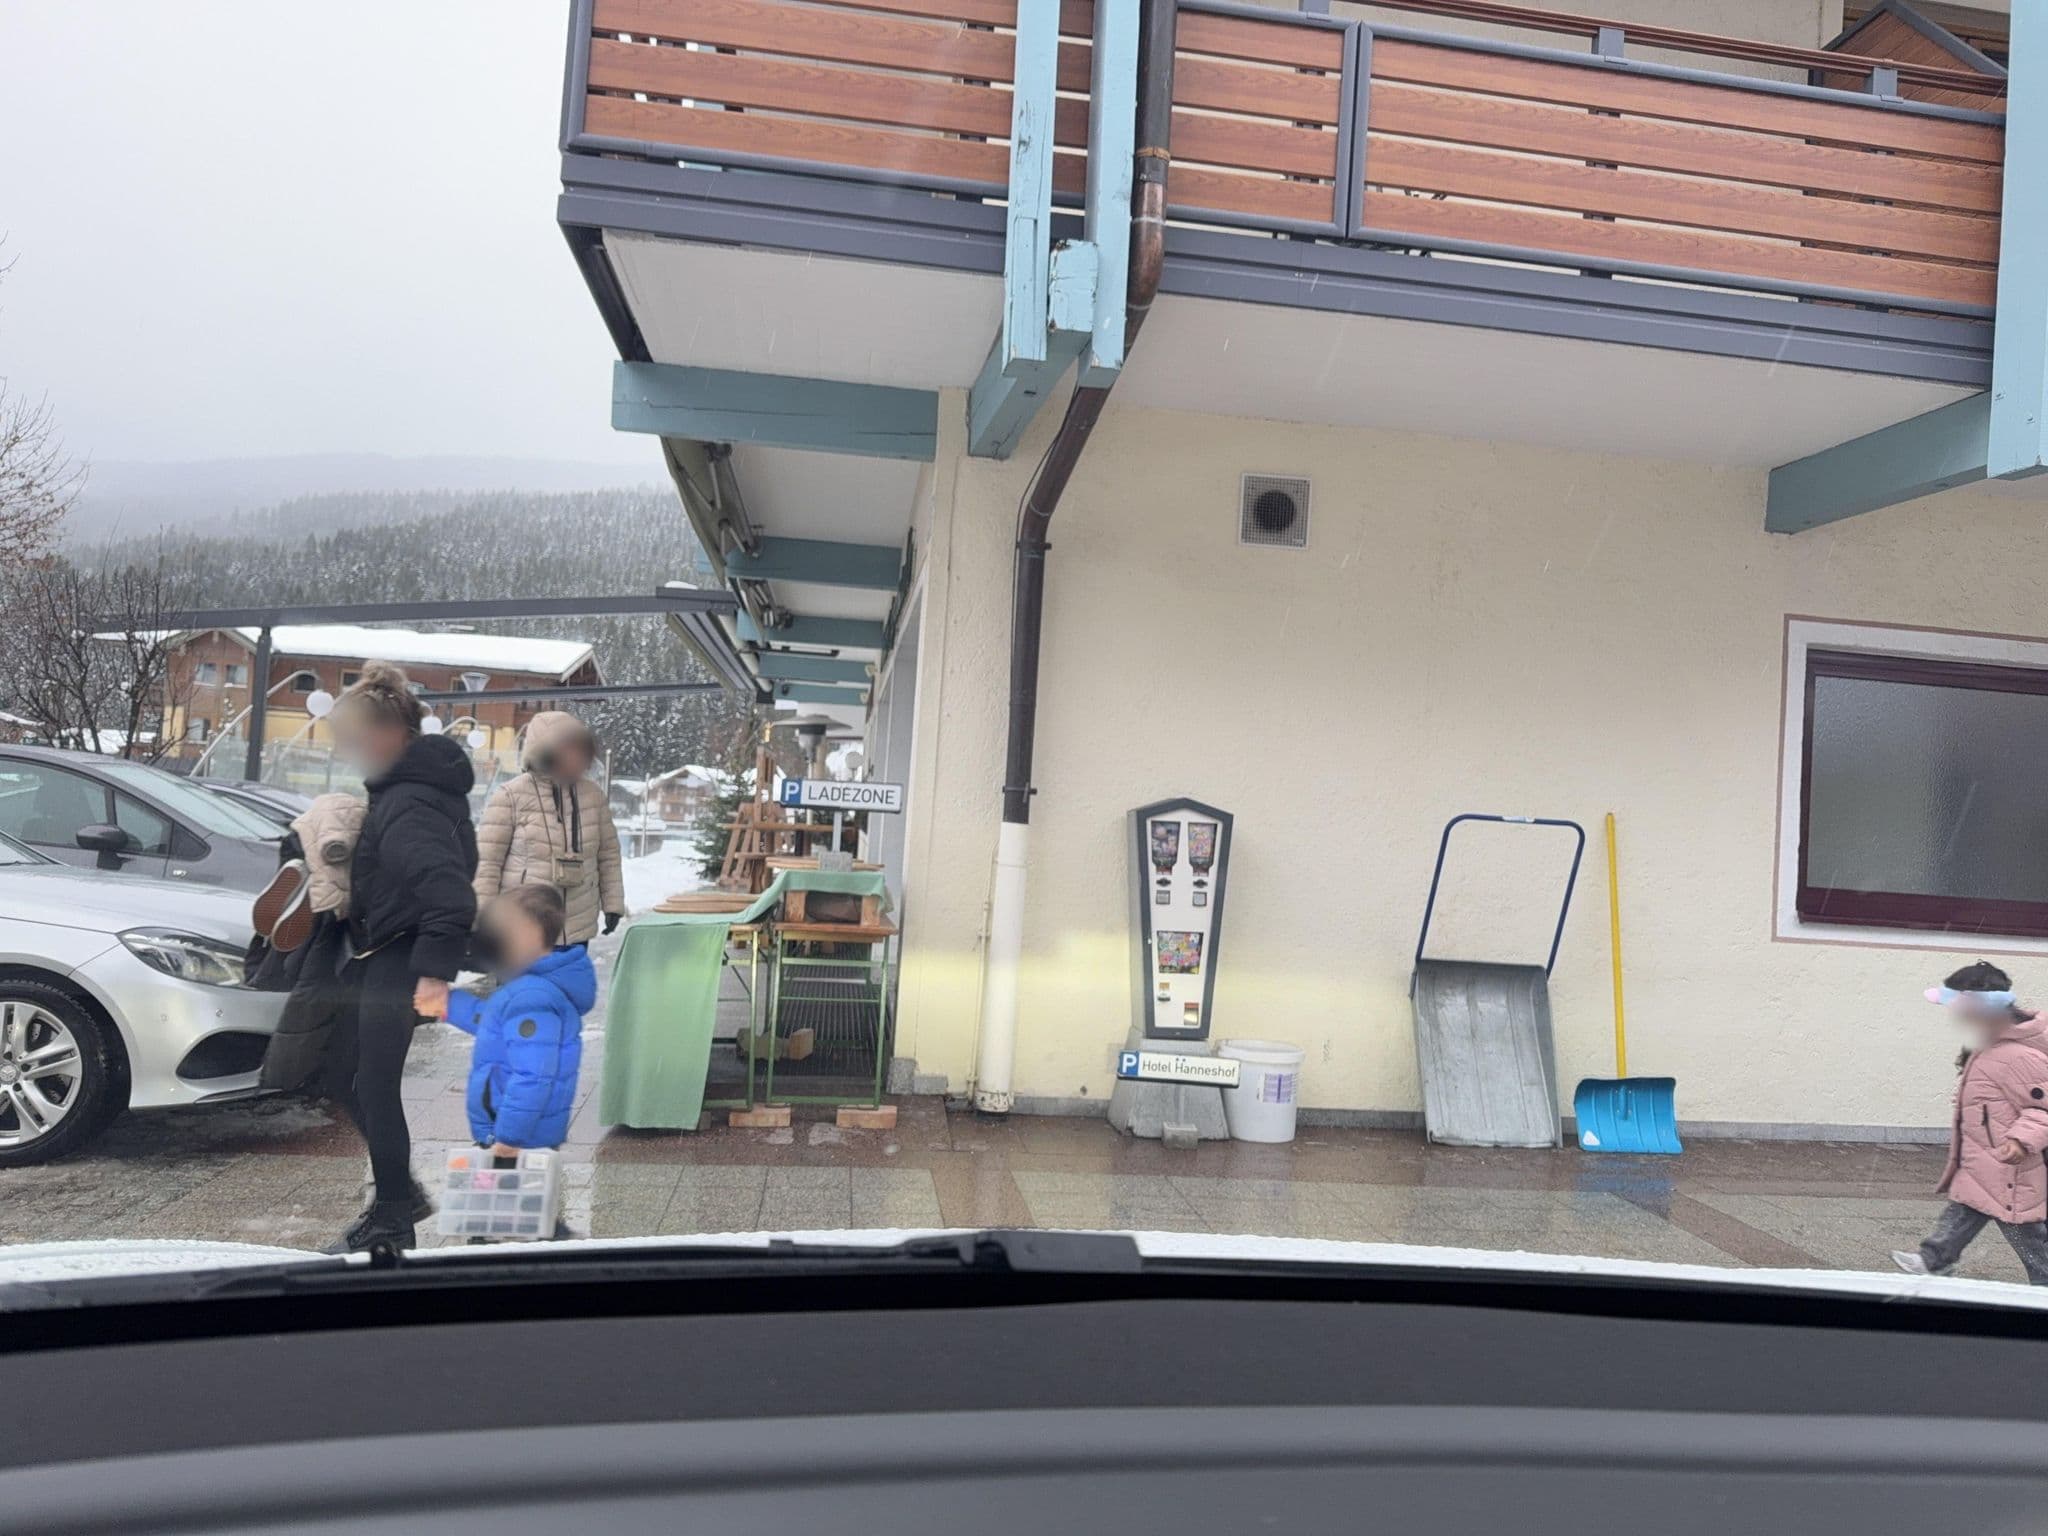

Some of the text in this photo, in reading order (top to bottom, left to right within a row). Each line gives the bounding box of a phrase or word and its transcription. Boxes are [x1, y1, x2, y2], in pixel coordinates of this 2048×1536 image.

[785, 782, 895, 804] P LADEZONE
[1122, 1054, 1236, 1078] P Hotel Hanneshof
